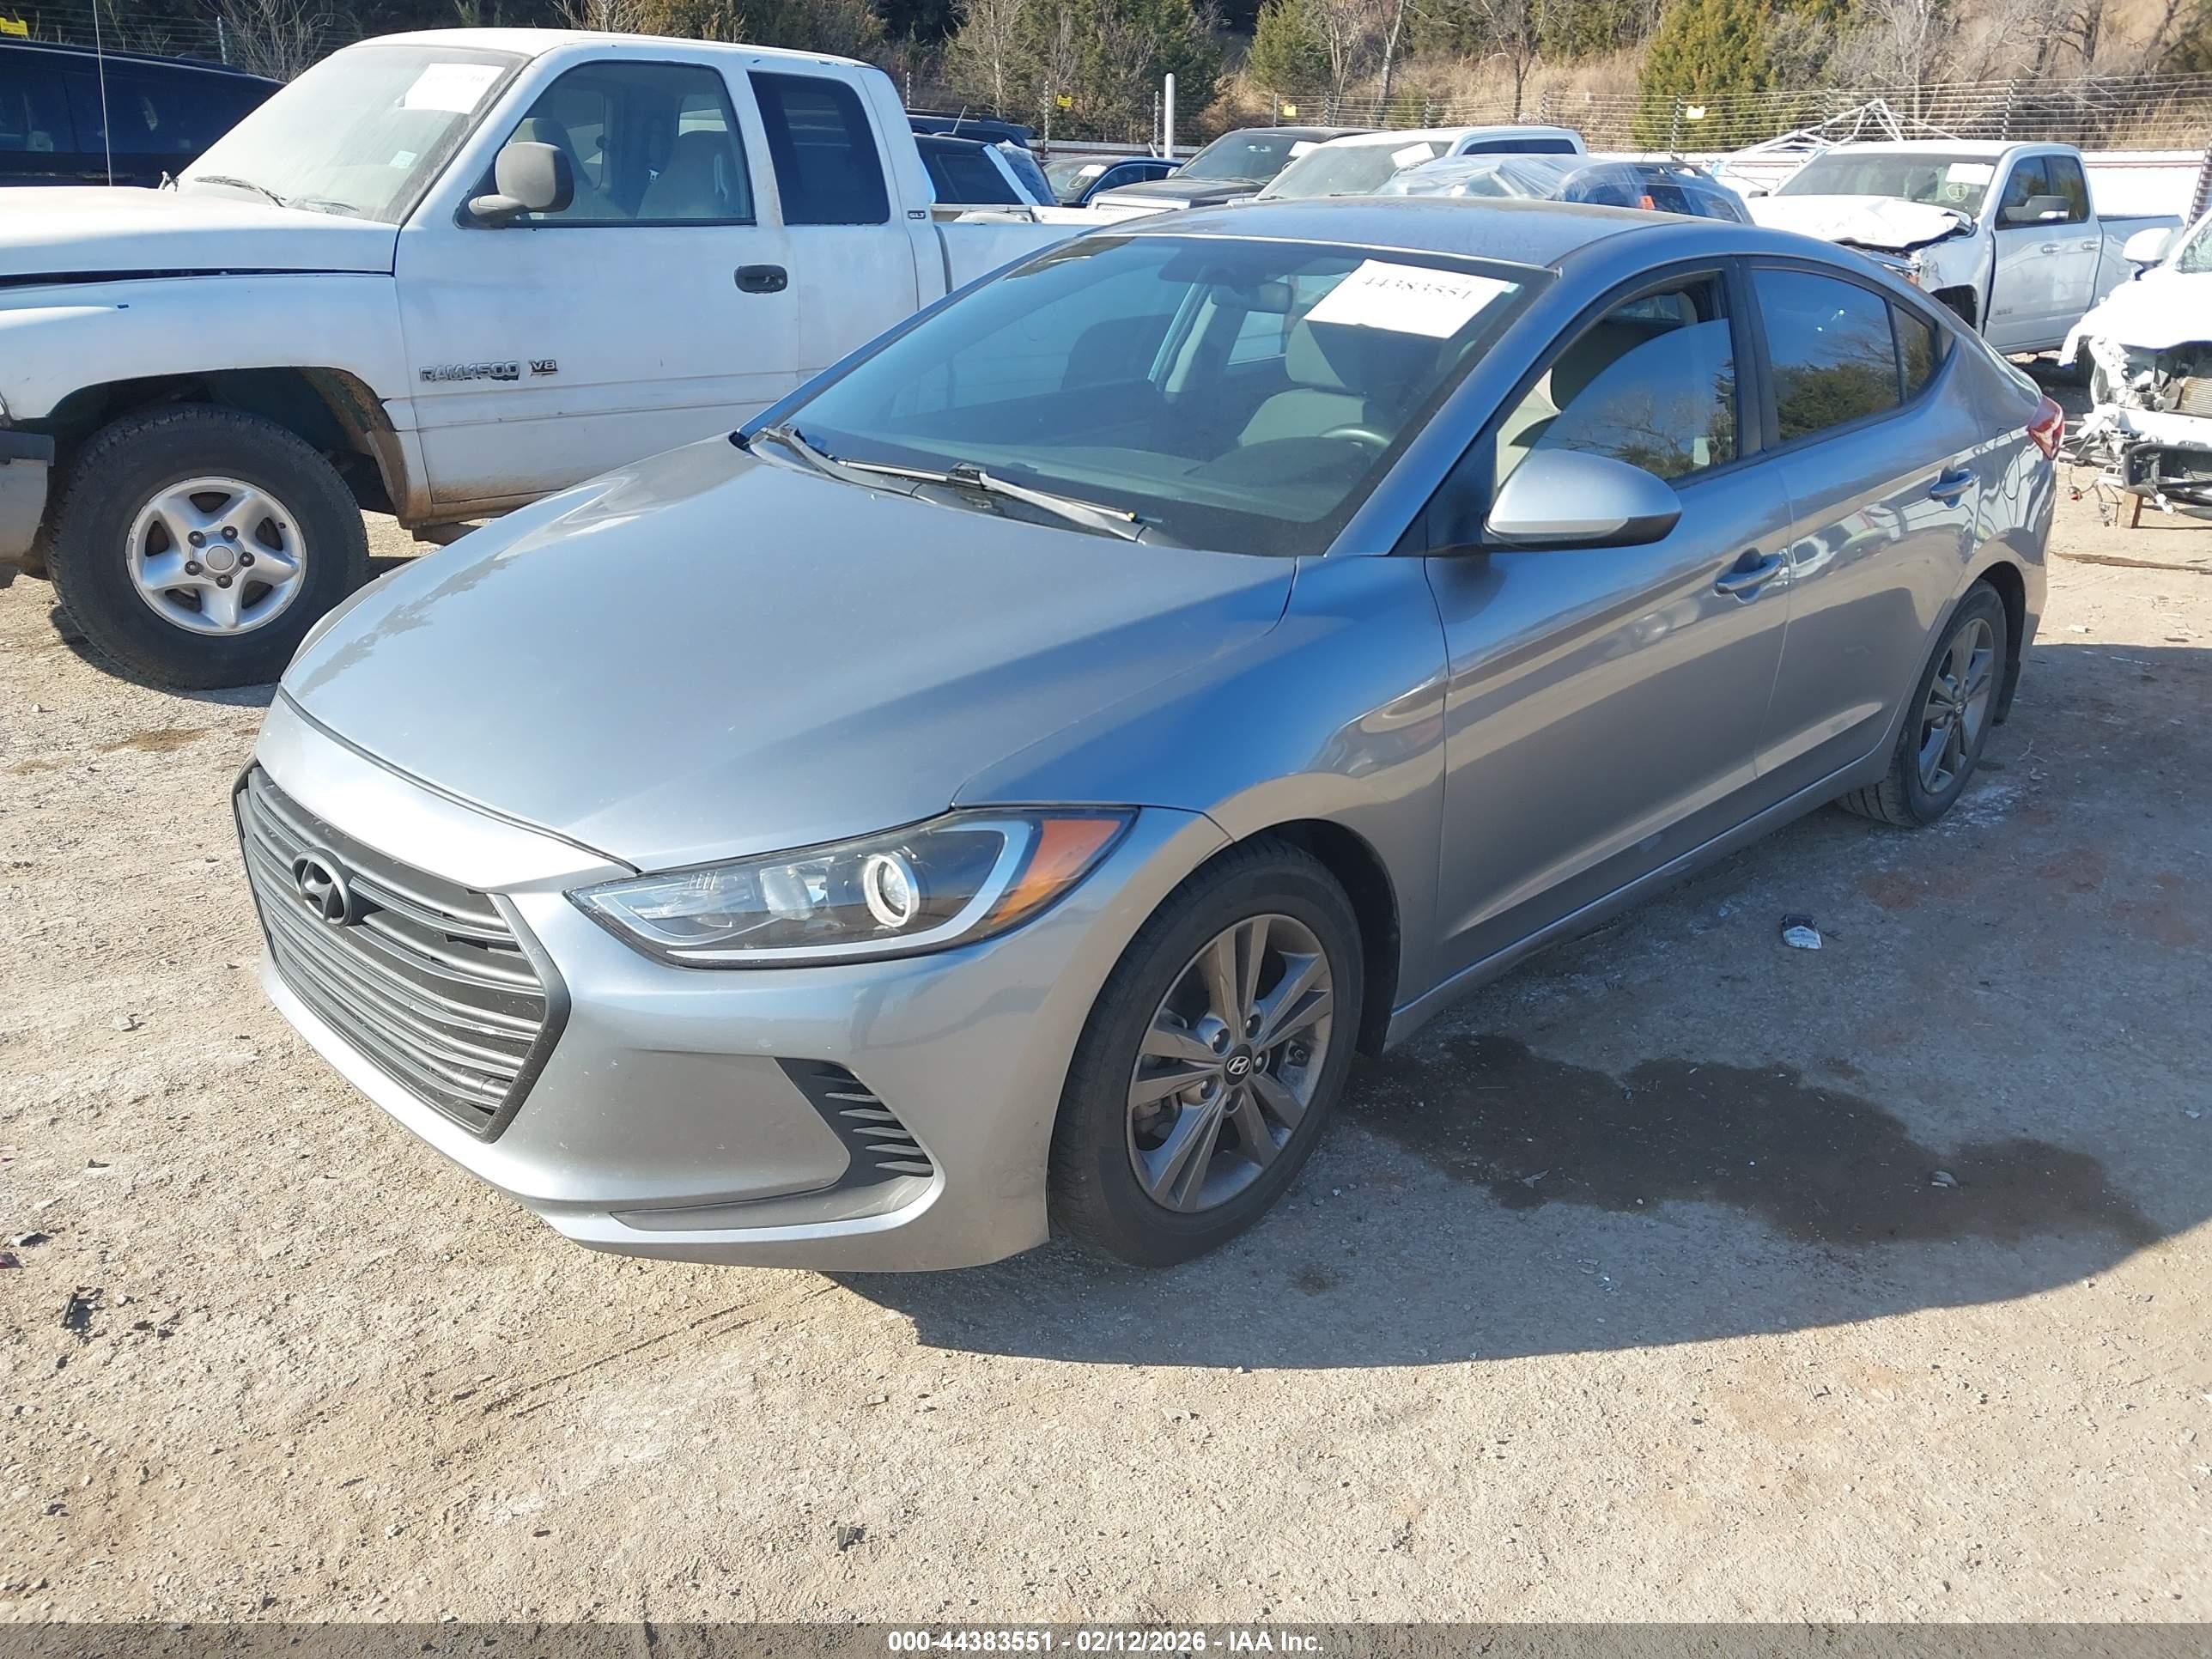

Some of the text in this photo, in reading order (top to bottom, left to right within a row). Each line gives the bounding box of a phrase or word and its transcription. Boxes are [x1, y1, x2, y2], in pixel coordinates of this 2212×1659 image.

[419, 361, 520, 381] RAM 1500
[530, 360, 556, 372] V8
